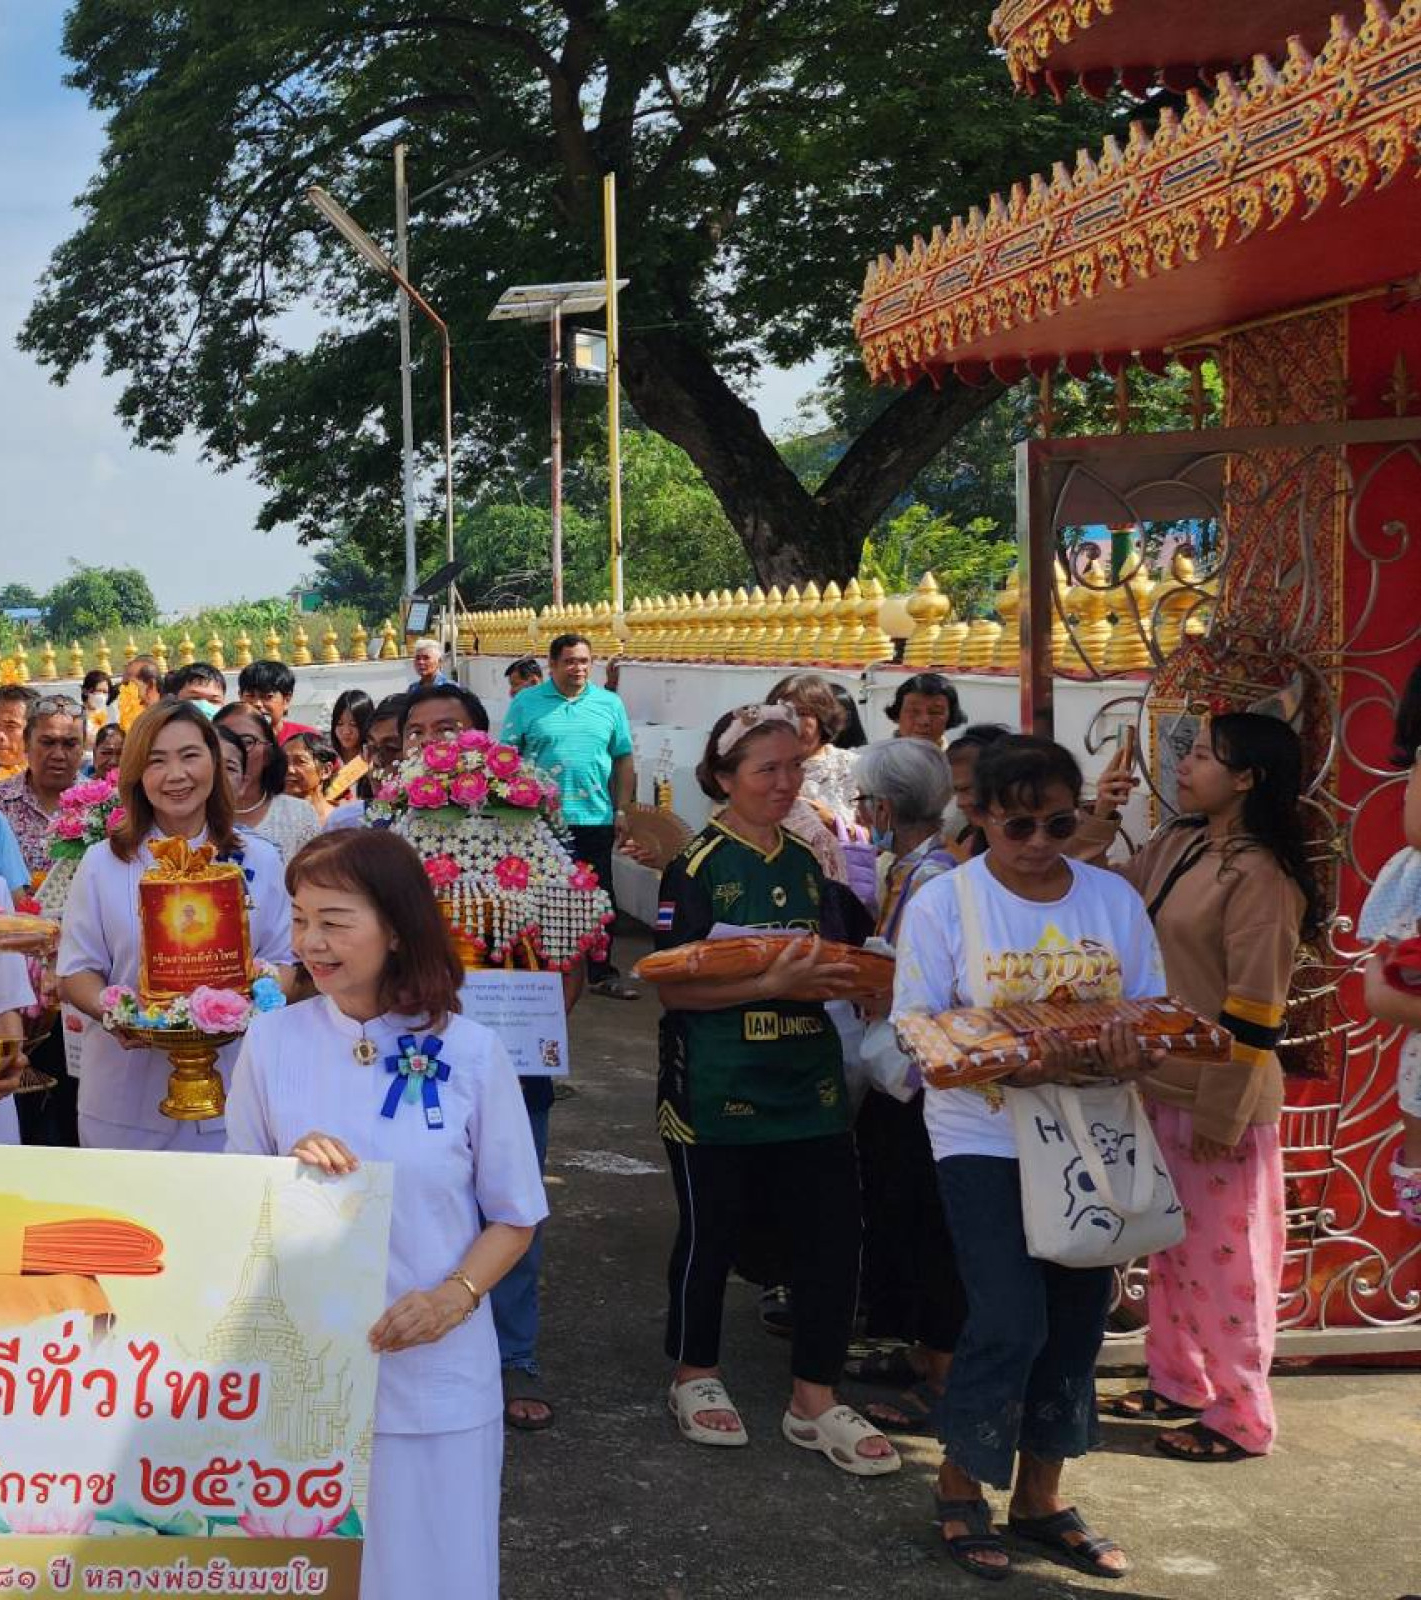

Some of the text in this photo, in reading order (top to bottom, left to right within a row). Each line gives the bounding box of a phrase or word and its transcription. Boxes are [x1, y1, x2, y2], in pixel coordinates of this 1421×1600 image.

[139, 1456, 344, 1507] ๒๕๖๘
[51, 1558, 72, 1588] ปี
[85, 1559, 325, 1591] หลวงพ่อธัมมชโย
